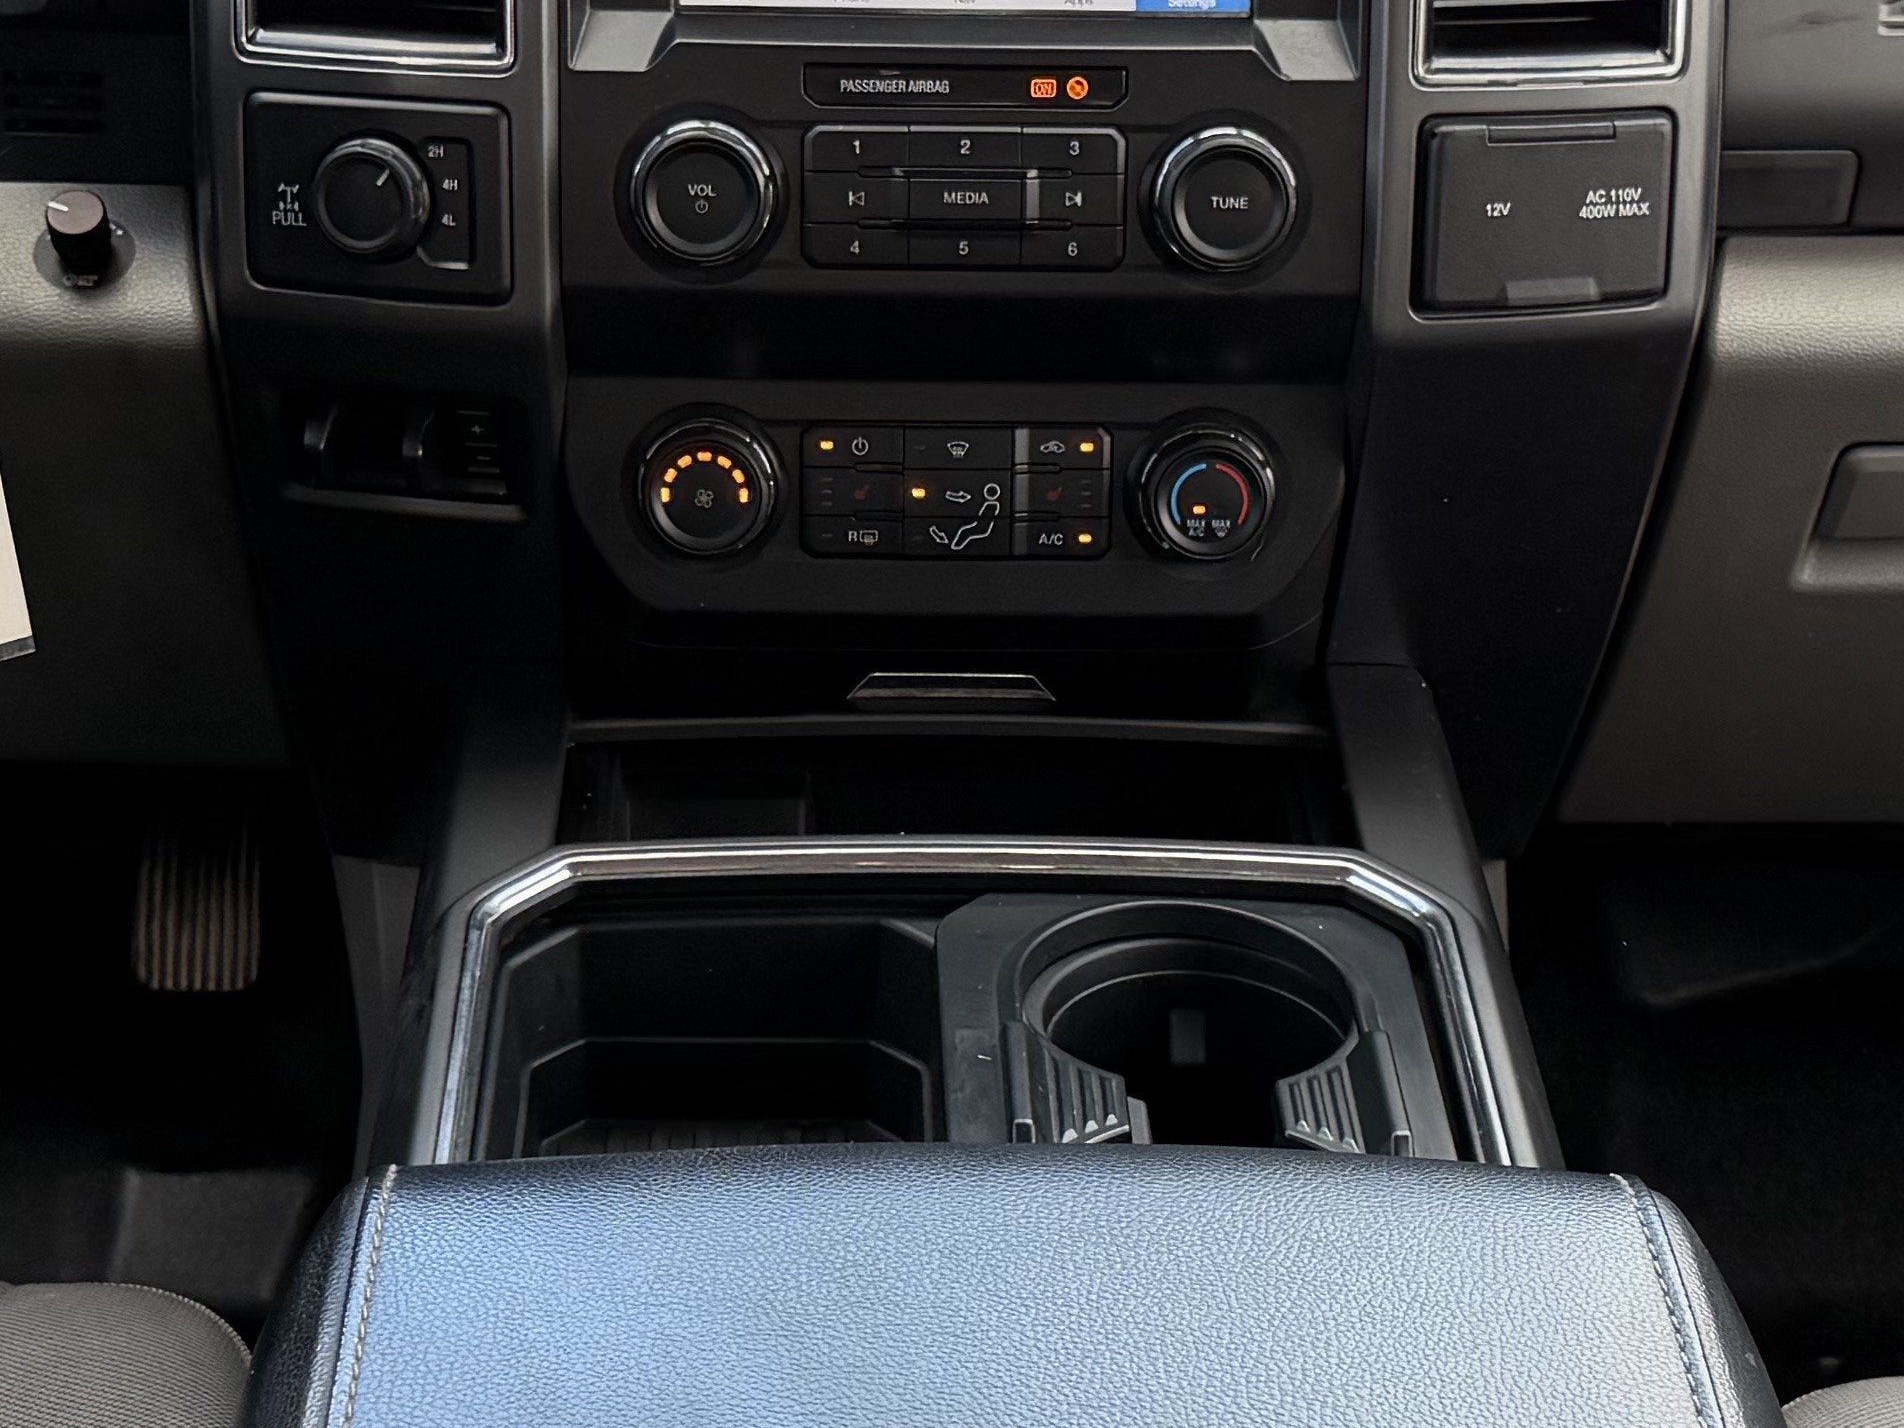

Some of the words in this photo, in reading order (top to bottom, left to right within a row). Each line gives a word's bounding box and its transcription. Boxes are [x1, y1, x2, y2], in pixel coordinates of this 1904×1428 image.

[840, 78, 905, 94] PASSENGER
[907, 78, 950, 95] AIRBAG
[1033, 80, 1054, 96] ON
[427, 145, 444, 159] 2H
[852, 139, 861, 155] 1
[960, 139, 971, 155] 2
[1069, 140, 1080, 156] 3
[442, 178, 458, 192] 4H
[687, 184, 717, 198] VOL
[943, 191, 990, 205] MEDIA
[1210, 196, 1249, 210] TUNE
[1586, 190, 1605, 205] AC
[1610, 188, 1642, 203] 110V
[1486, 203, 1510, 217] 12V
[1579, 204, 1615, 219] 400W
[1618, 203, 1650, 217] MAX
[272, 211, 307, 227] PULL
[441, 213, 456, 226] 4L
[849, 240, 861, 255] 4
[959, 241, 969, 256] 5
[1067, 241, 1078, 257] 6
[1038, 532, 1064, 547] A/C
